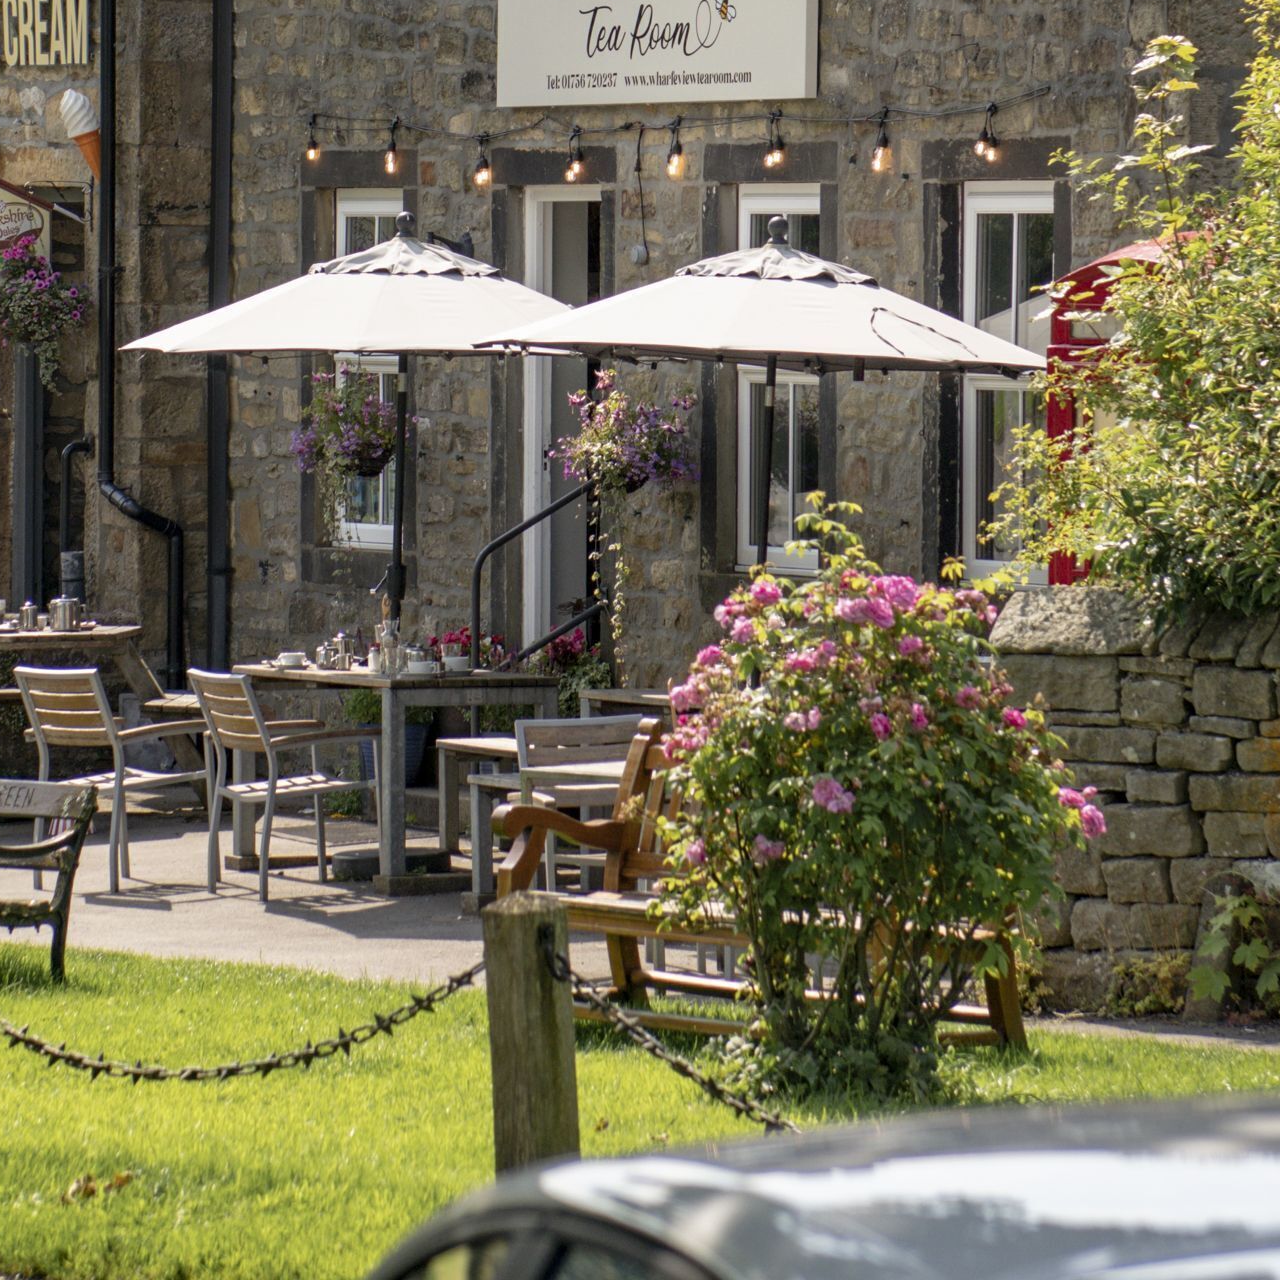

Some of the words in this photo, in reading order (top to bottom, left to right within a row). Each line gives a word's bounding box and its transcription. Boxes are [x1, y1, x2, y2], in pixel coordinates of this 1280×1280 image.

[579, 6, 626, 58] Tea
[630, 3, 700, 60] Room
[546, 74, 560, 90] Tel:
[561, 73, 586, 89] 01756
[587, 72, 618, 88] 720237
[624, 70, 752, 87] www.wharfeviewtearoom.com
